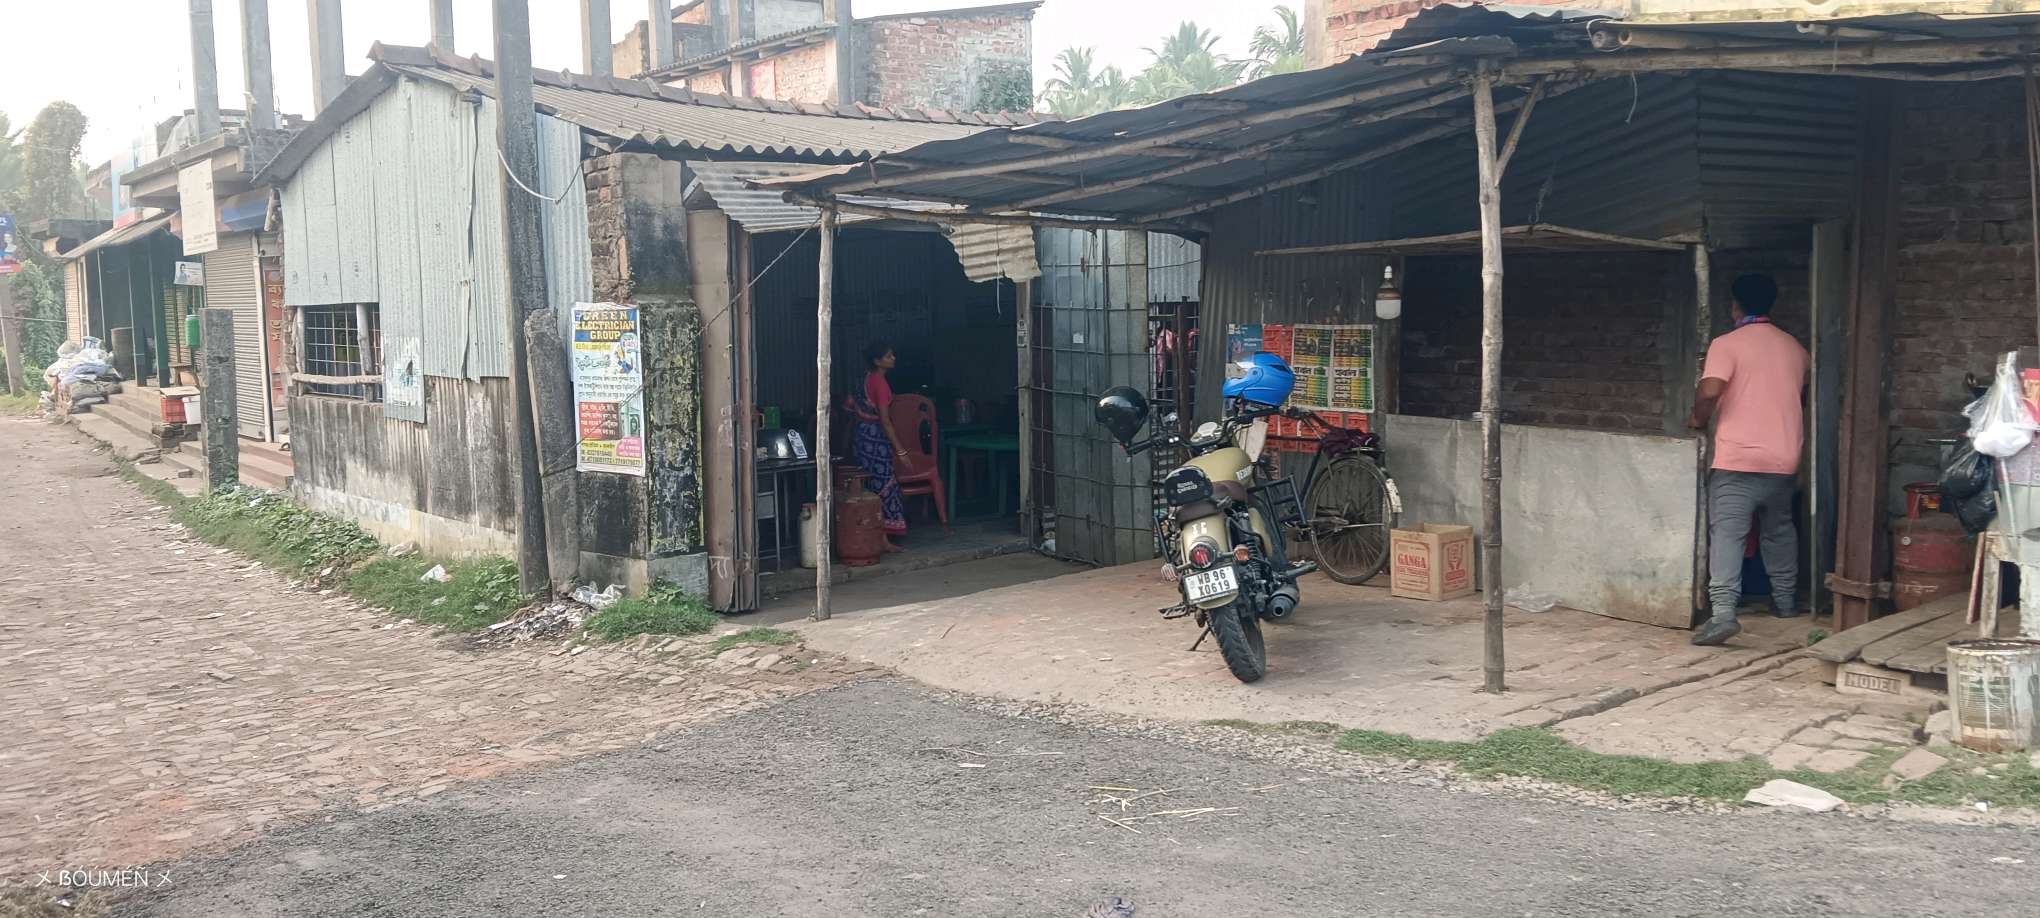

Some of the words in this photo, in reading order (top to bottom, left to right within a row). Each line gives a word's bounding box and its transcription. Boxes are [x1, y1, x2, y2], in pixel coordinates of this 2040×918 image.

[583, 311, 627, 320] GREEN
[576, 320, 635, 330] ELECTRICIAN
[590, 331, 621, 340] GROUP
[1398, 554, 1427, 568] GANGA
[1197, 573, 1211, 584] WB
[1214, 569, 1226, 580] 96
[1198, 580, 1230, 595] X0619
[1845, 672, 1901, 695] MODEL
